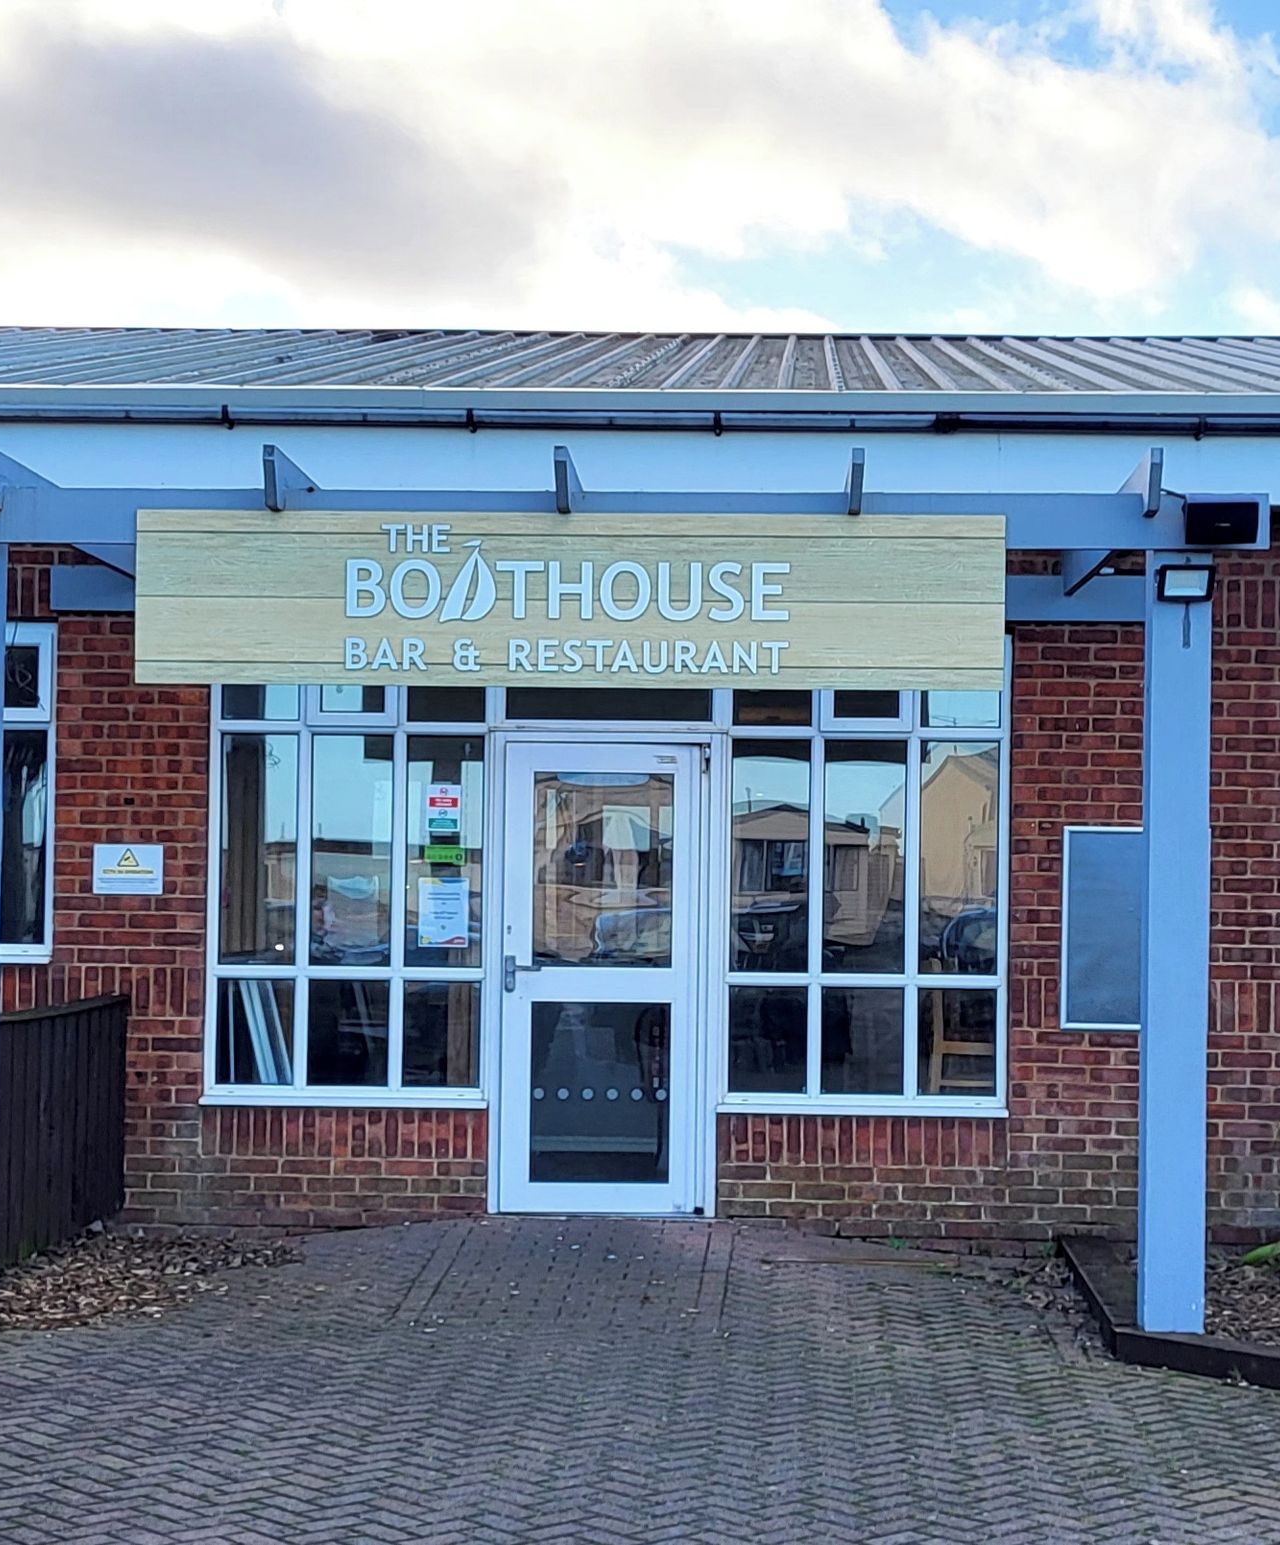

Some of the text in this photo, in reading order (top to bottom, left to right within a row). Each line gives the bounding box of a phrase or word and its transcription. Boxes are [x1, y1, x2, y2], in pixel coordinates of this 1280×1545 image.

[381, 523, 451, 553] THE
[344, 540, 792, 623] BOATHOUSE
[344, 636, 791, 675] BAR & RESTAURANT
